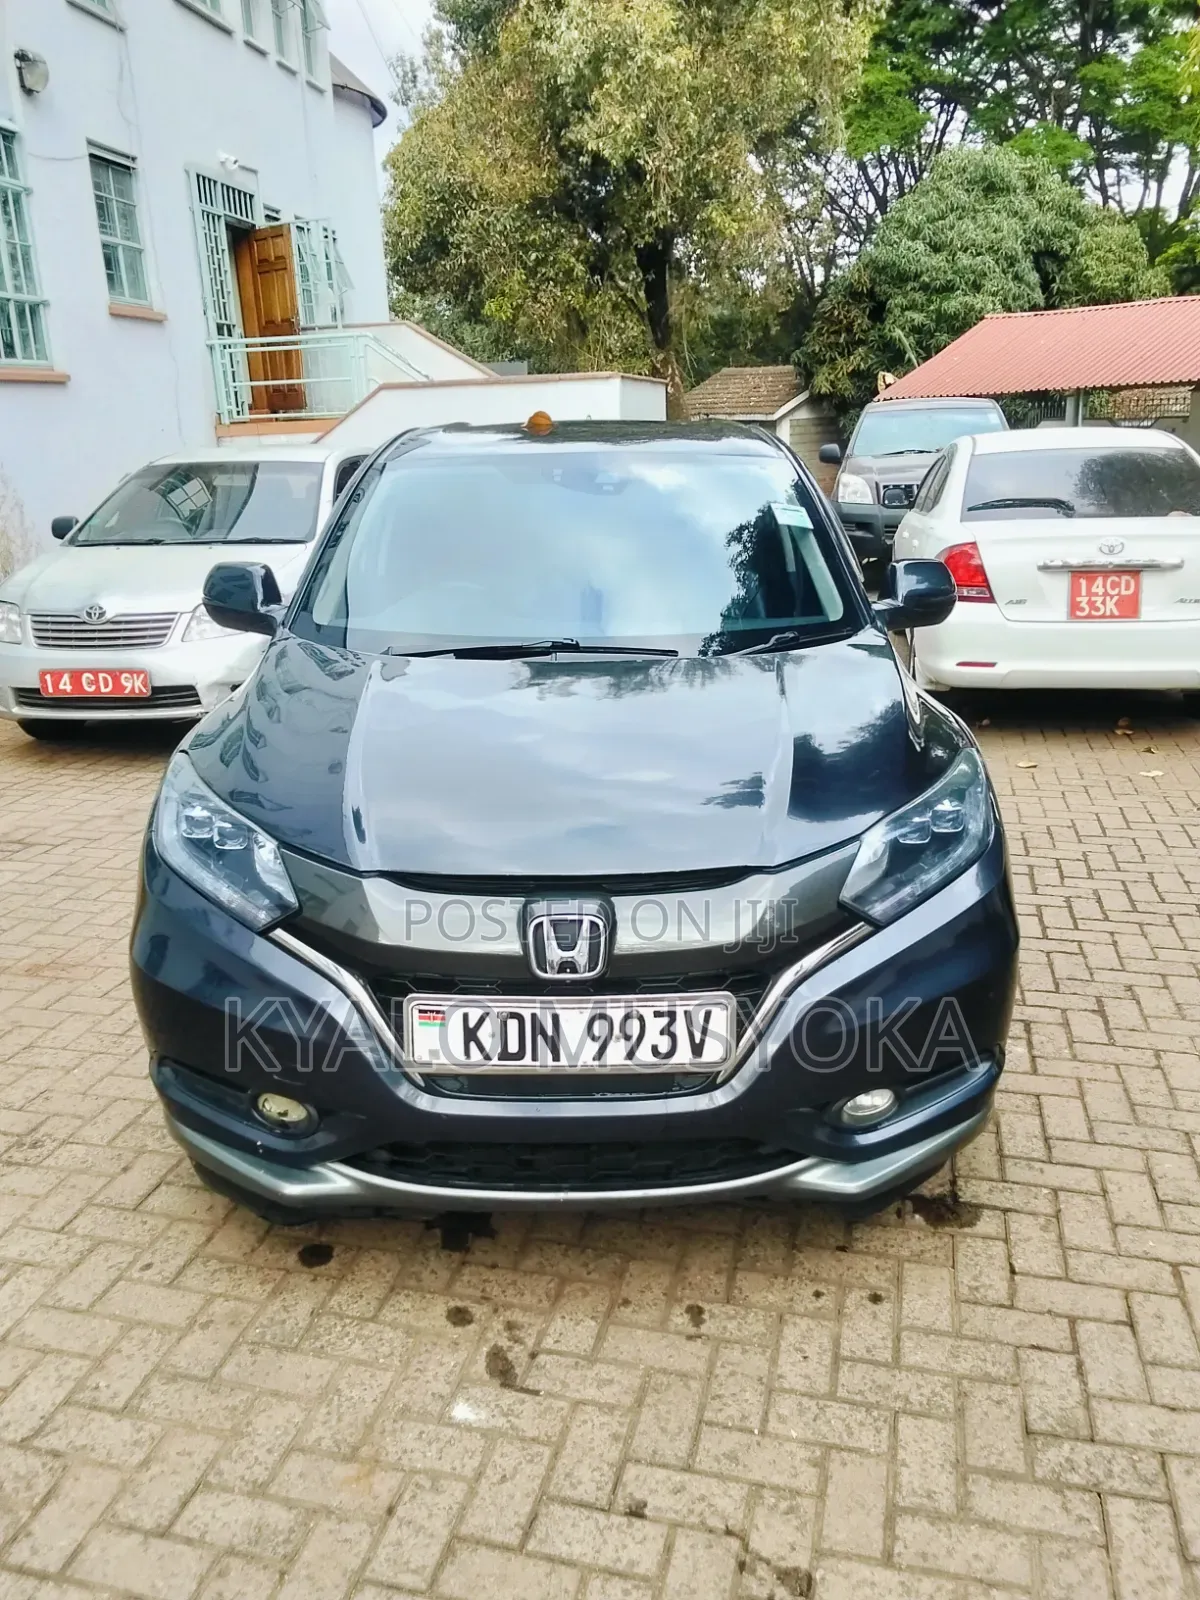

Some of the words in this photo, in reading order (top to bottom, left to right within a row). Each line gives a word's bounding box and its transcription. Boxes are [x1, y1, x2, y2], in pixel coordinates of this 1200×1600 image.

[1079, 576, 1136, 596] 14CD
[1075, 596, 1120, 616] 33K
[44, 673, 72, 693] 14
[81, 672, 113, 693] CD
[121, 672, 147, 694] 9K
[462, 1010, 561, 1063] KDN
[586, 1008, 713, 1063] 993V
